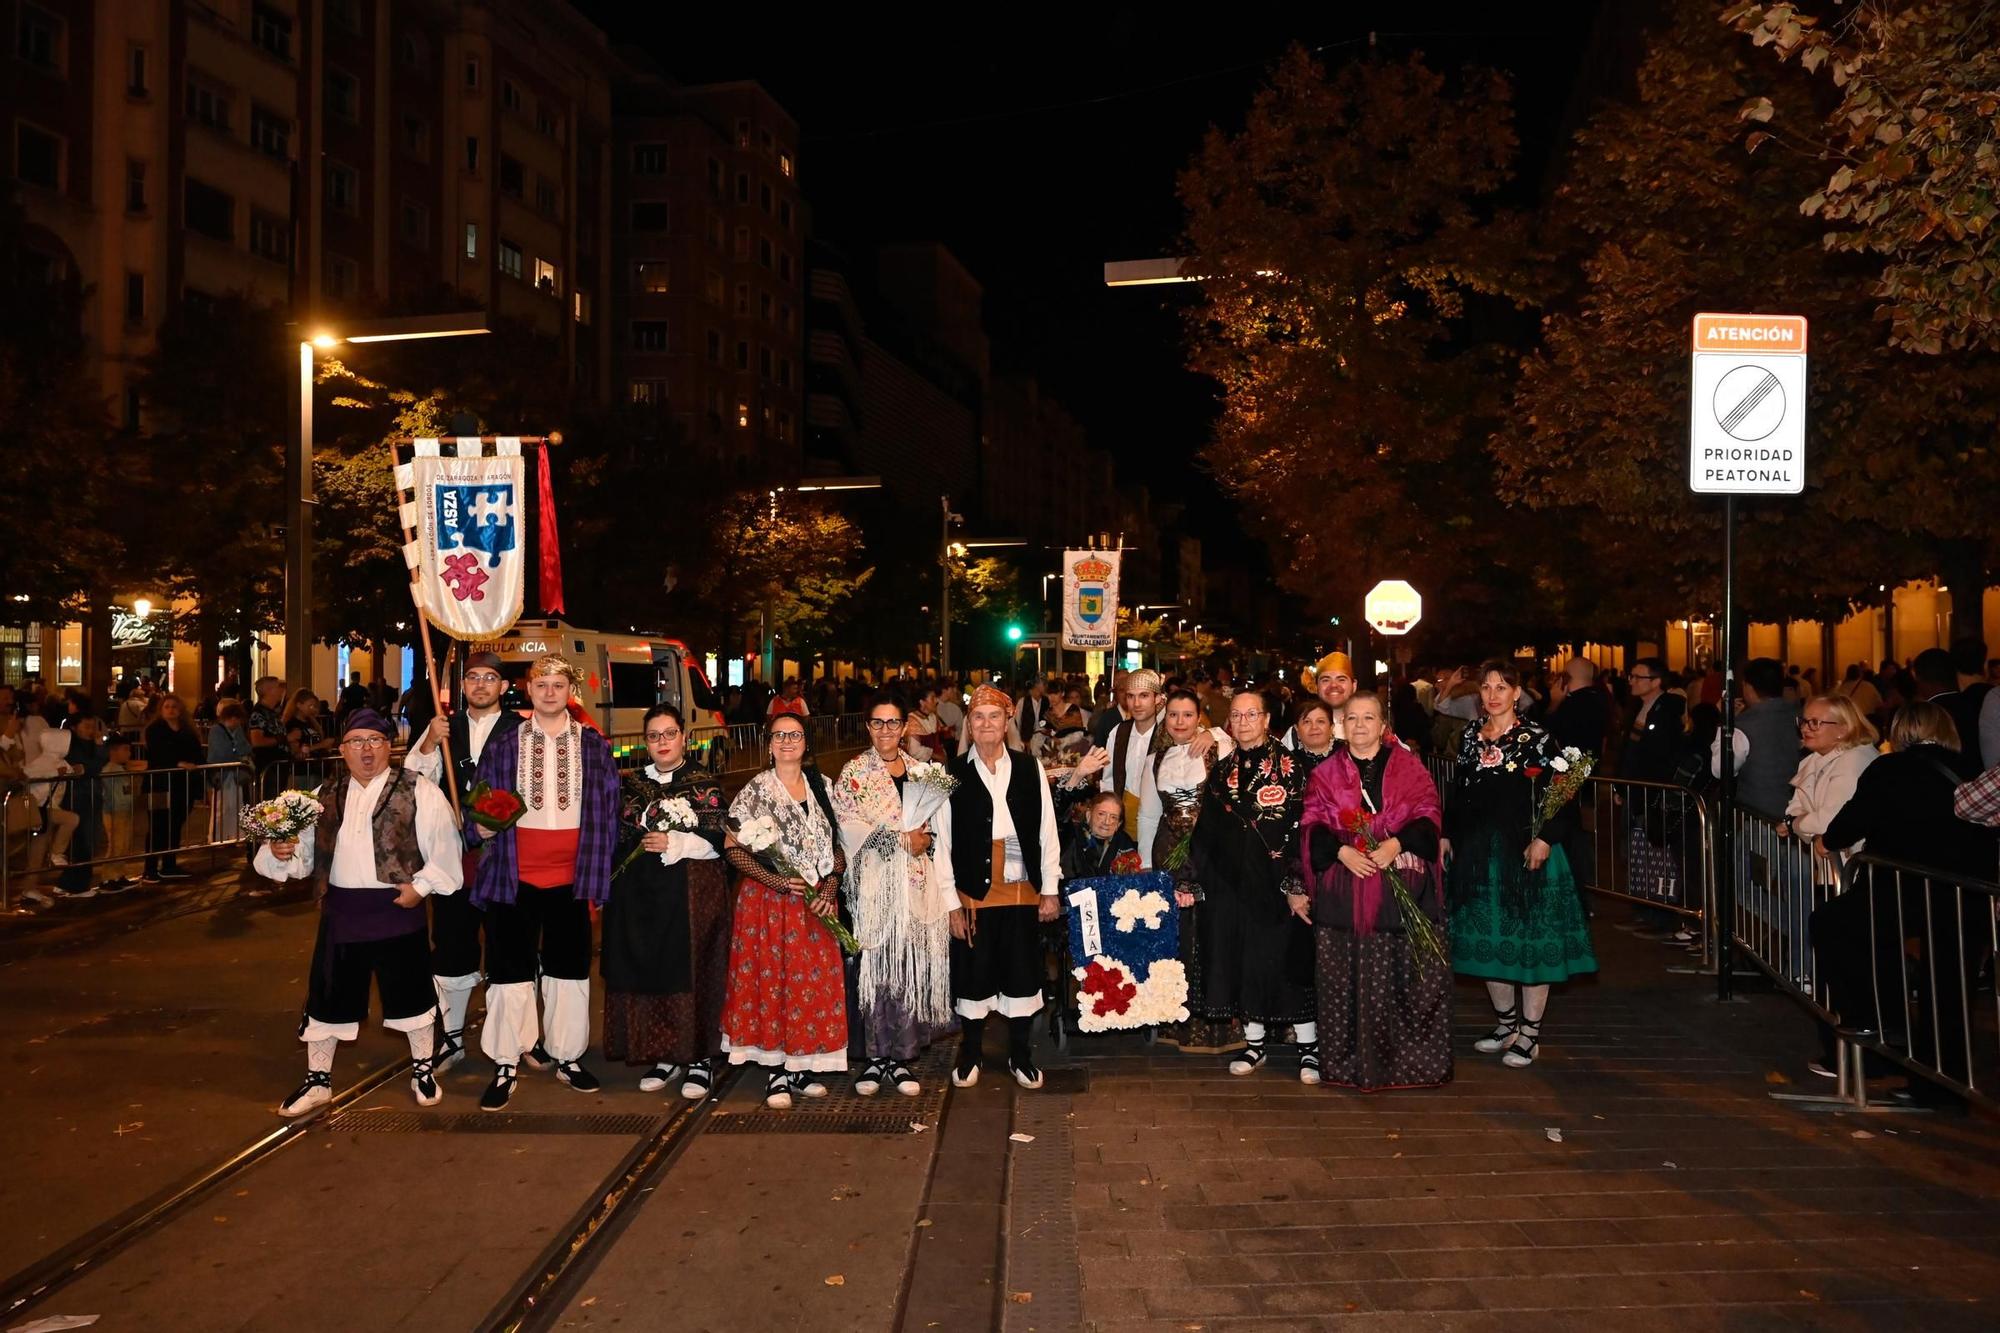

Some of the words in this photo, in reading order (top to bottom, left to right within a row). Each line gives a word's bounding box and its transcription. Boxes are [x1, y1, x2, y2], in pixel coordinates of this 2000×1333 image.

[1707, 325, 1794, 342] ATENCIÓN
[1704, 448, 1793, 461] PRIORIDAD
[487, 472, 512, 481] ARAGÓN
[1705, 469, 1791, 482] PEATONAL
[443, 490, 458, 528] ASZA
